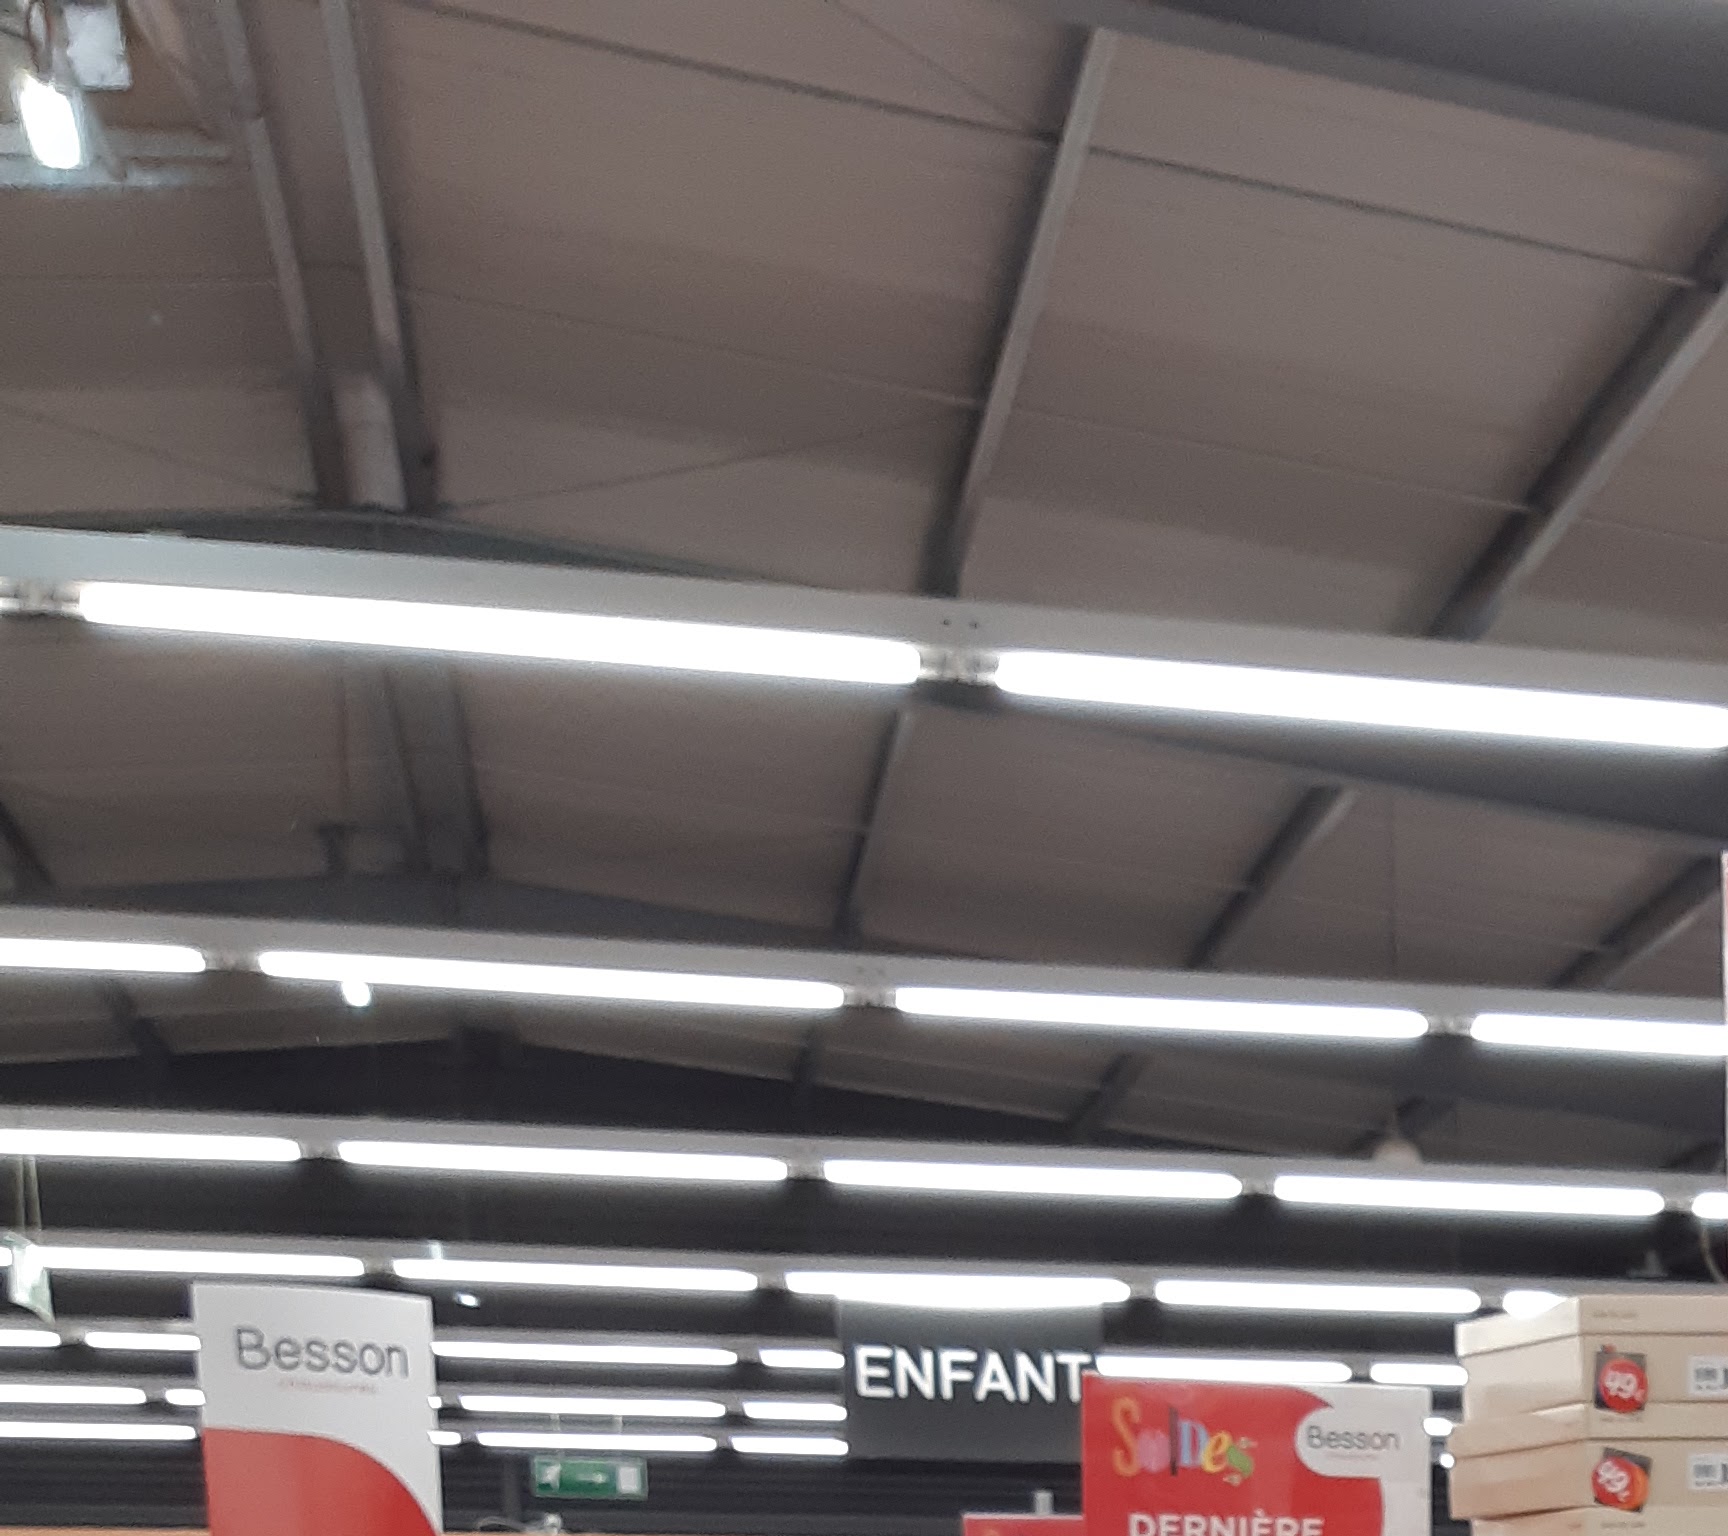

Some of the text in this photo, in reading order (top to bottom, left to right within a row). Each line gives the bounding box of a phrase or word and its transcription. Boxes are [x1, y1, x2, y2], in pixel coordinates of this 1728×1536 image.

[236, 1326, 410, 1379] Besson
[854, 1345, 1093, 1403] ENFANT
[1307, 1425, 1398, 1451] Besson
